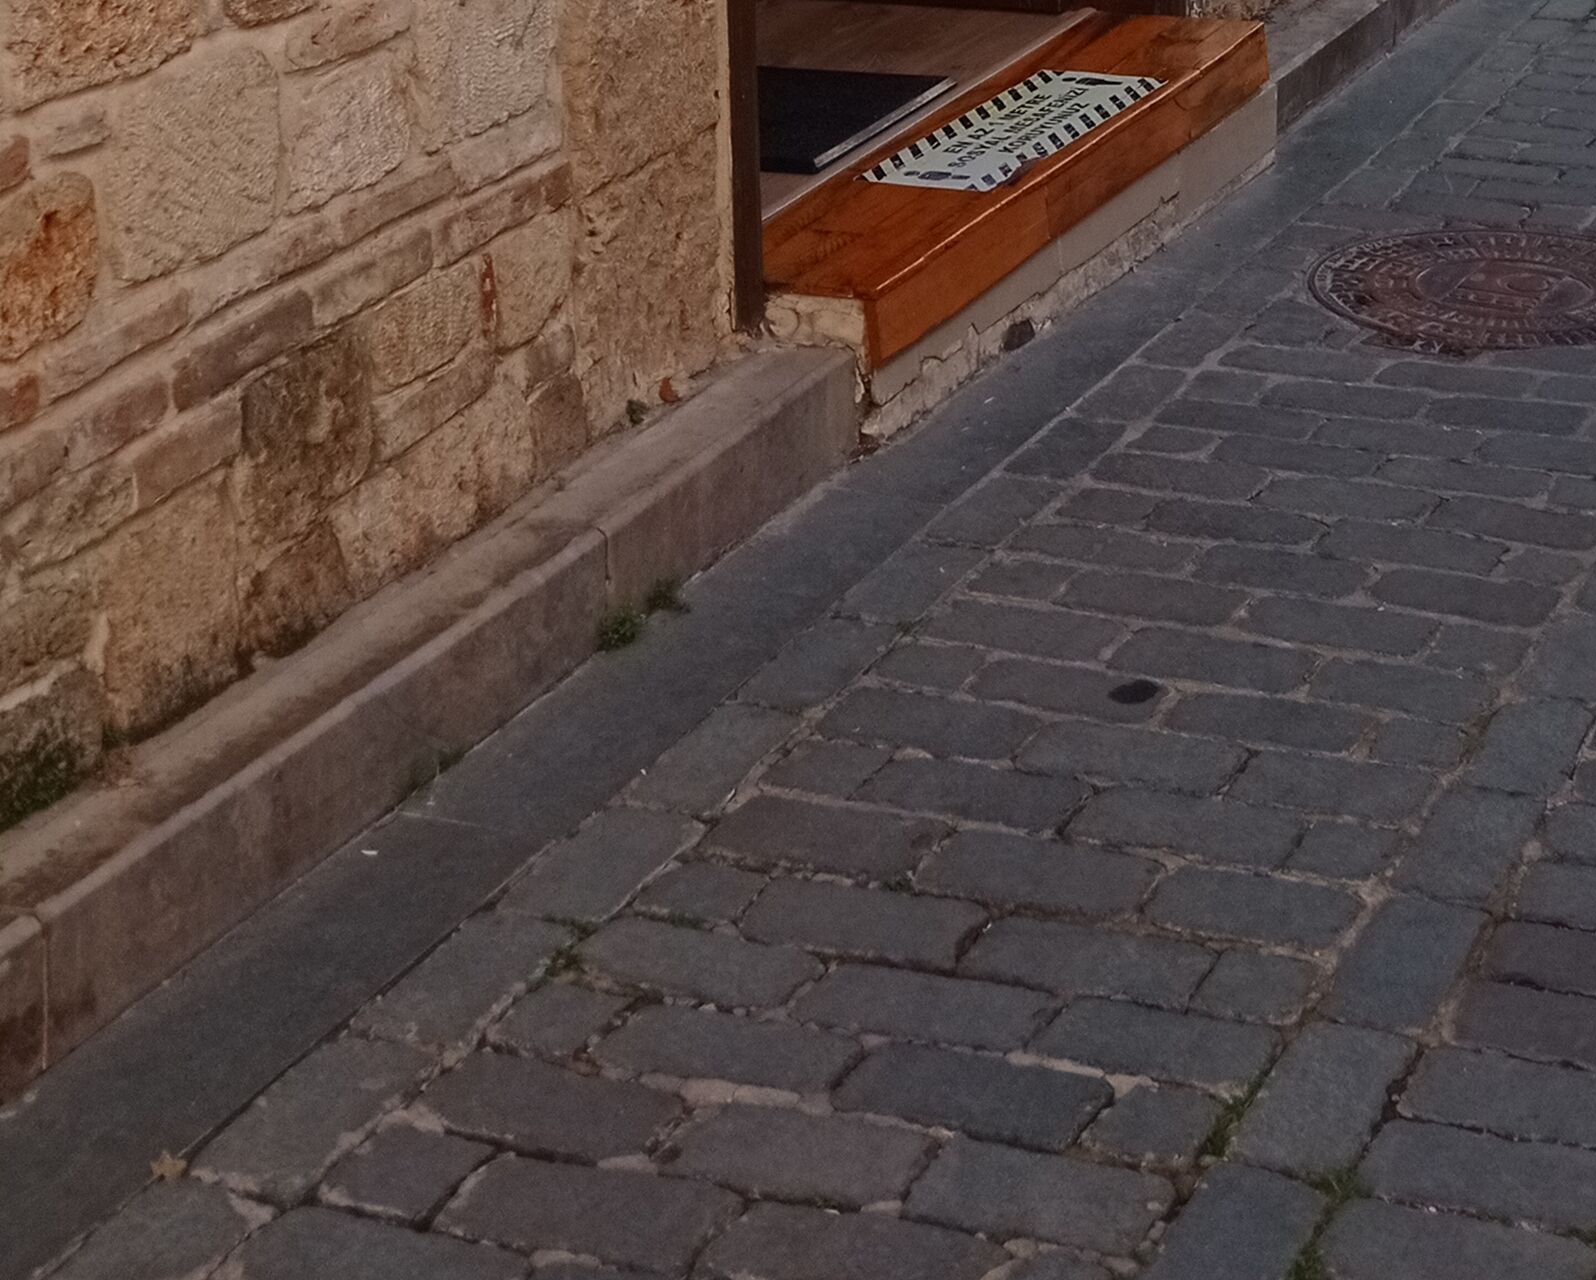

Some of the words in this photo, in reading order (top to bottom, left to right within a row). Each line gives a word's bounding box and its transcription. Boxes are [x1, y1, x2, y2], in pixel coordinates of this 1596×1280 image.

[968, 128, 995, 140] AZ
[998, 94, 1052, 121] METRE
[947, 135, 1011, 168] SOSYAL
